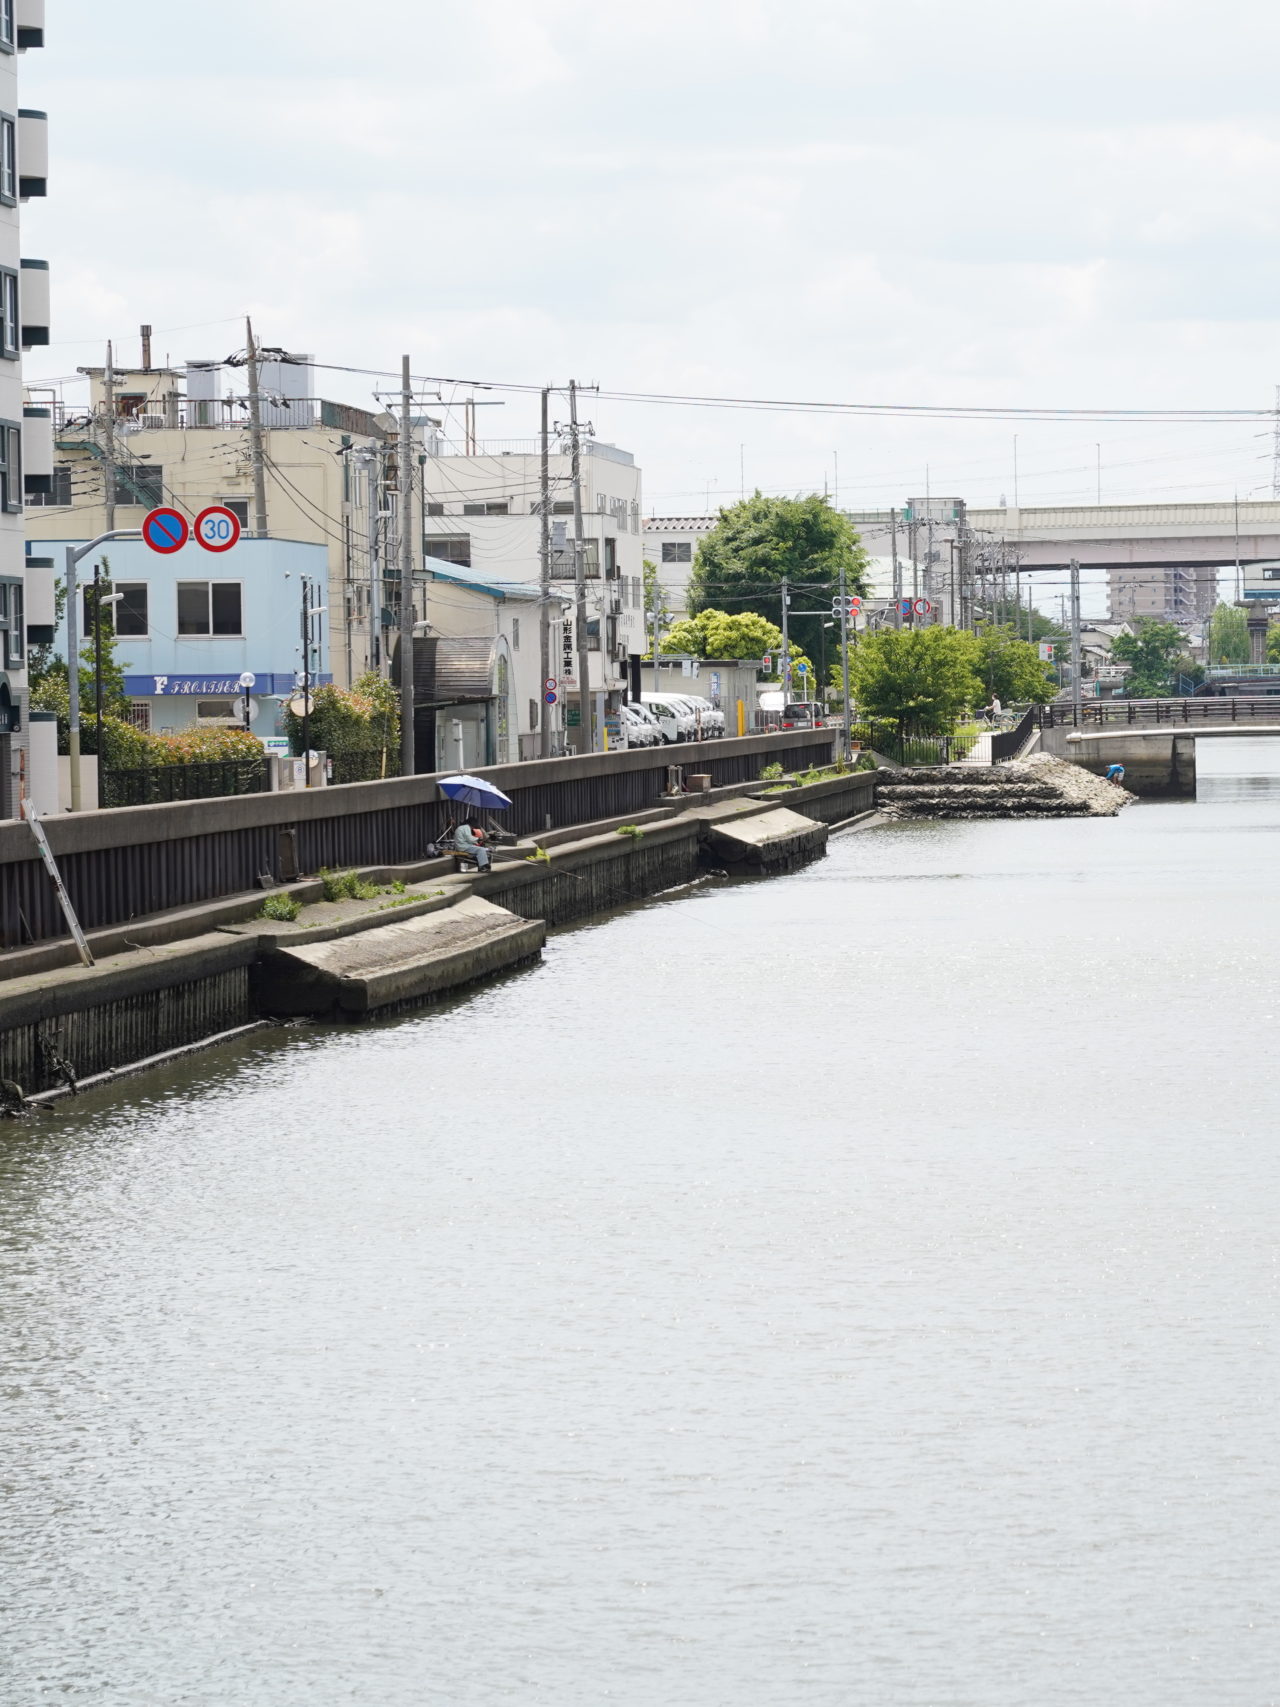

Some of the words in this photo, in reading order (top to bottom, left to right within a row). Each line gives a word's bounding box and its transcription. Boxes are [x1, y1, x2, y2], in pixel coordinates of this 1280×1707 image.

[204, 519, 230, 540] 30
[153, 676, 168, 695] F
[170, 680, 241, 694] FRONTIER
